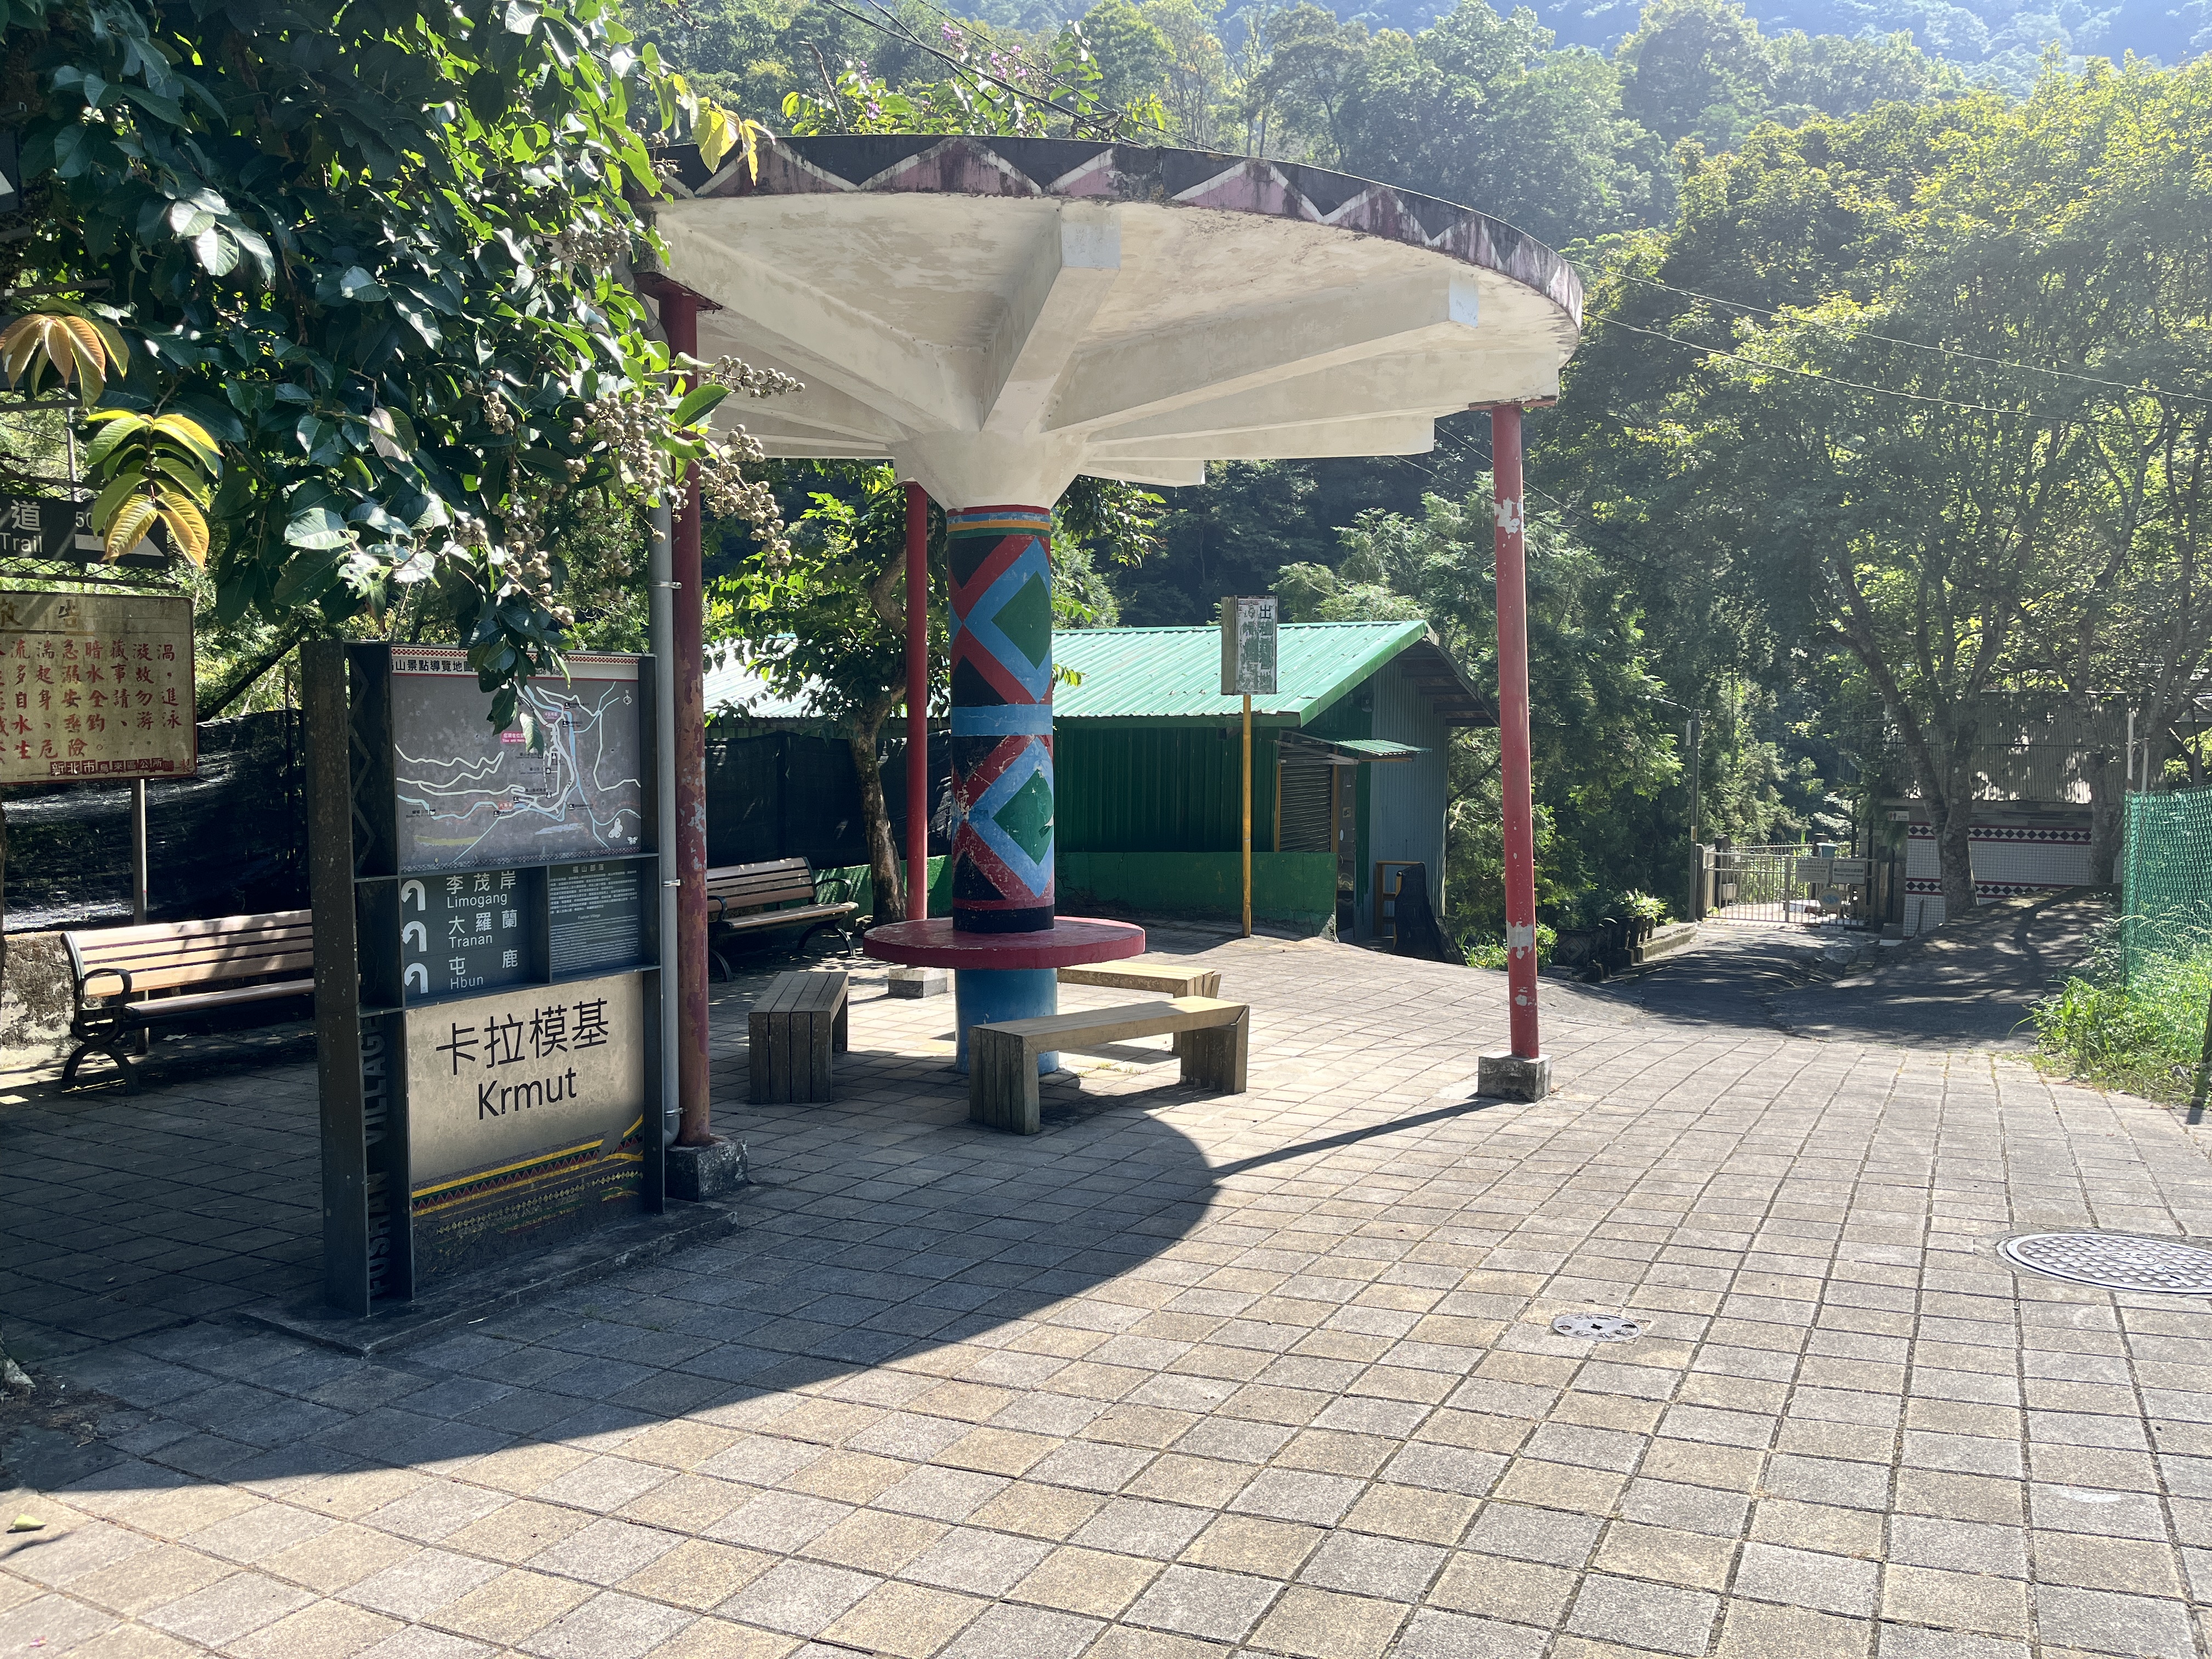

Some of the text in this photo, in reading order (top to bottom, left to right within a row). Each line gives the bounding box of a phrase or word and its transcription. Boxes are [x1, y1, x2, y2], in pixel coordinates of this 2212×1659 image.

[0, 499, 41, 532] 道
[0, 532, 42, 553] Trail
[0, 638, 175, 662] 流湍急暗藏漩渦
[391, 659, 473, 673] 山景點導覽地圖
[446, 871, 516, 895] 李茂岸
[447, 893, 507, 909] Limogang
[448, 909, 517, 935] 大羅蘭
[449, 934, 493, 949] Tranan
[450, 974, 483, 990] Hbun
[436, 997, 608, 1076] 卡拉模基
[478, 1067, 577, 1120] Krmut
